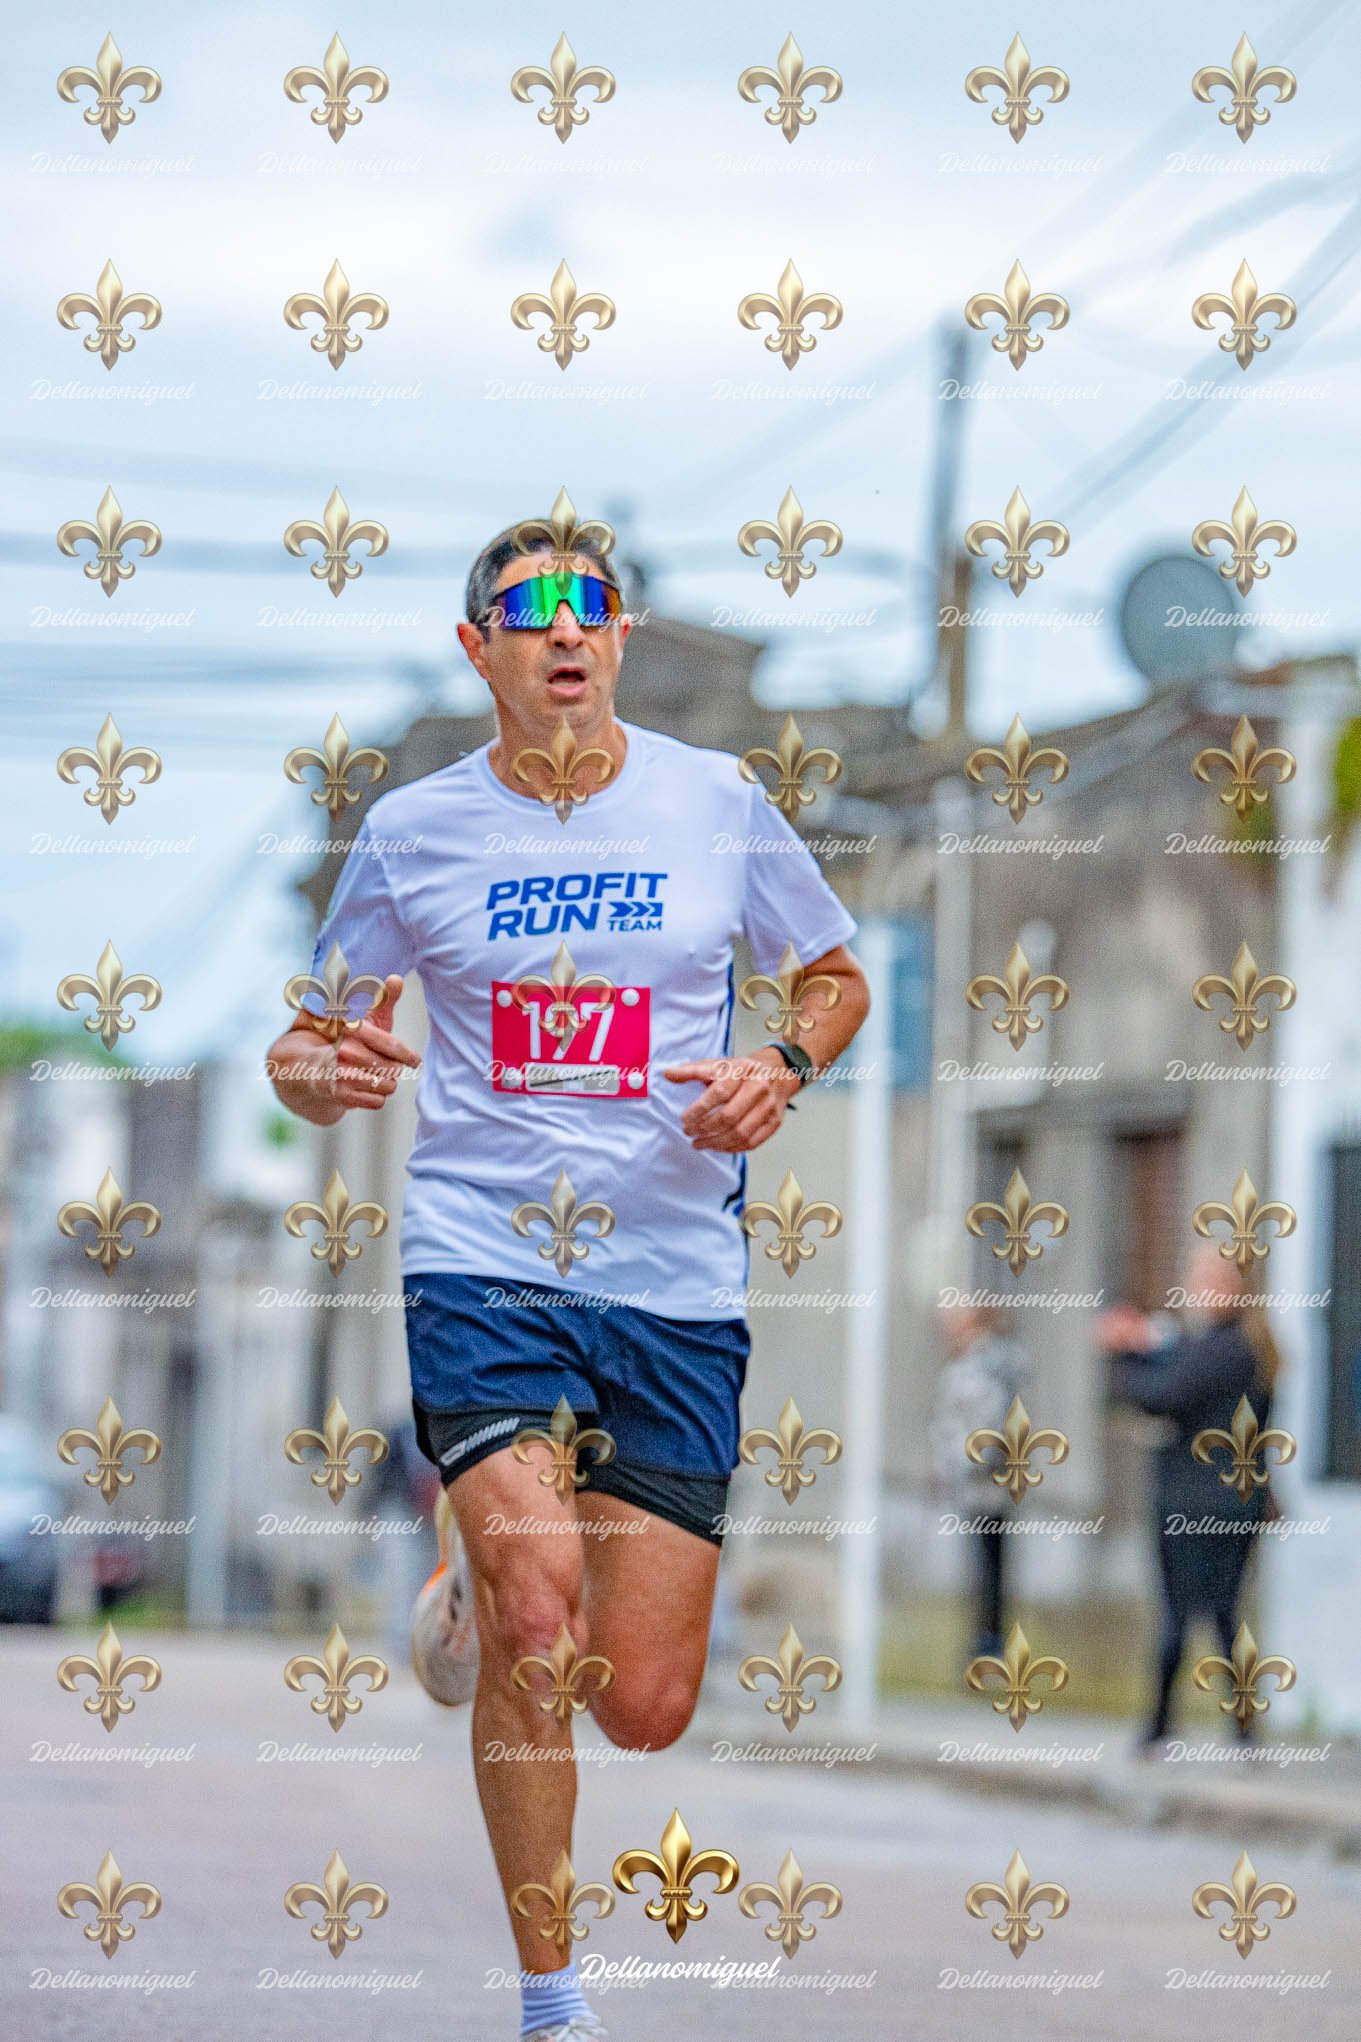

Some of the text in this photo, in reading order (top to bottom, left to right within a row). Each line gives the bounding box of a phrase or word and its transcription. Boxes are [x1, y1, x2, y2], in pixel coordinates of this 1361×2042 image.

[486, 872, 668, 910] PROFIT
[488, 903, 600, 940] RUN
[608, 919, 662, 932] TEAM
[522, 1001, 615, 1062] 197
